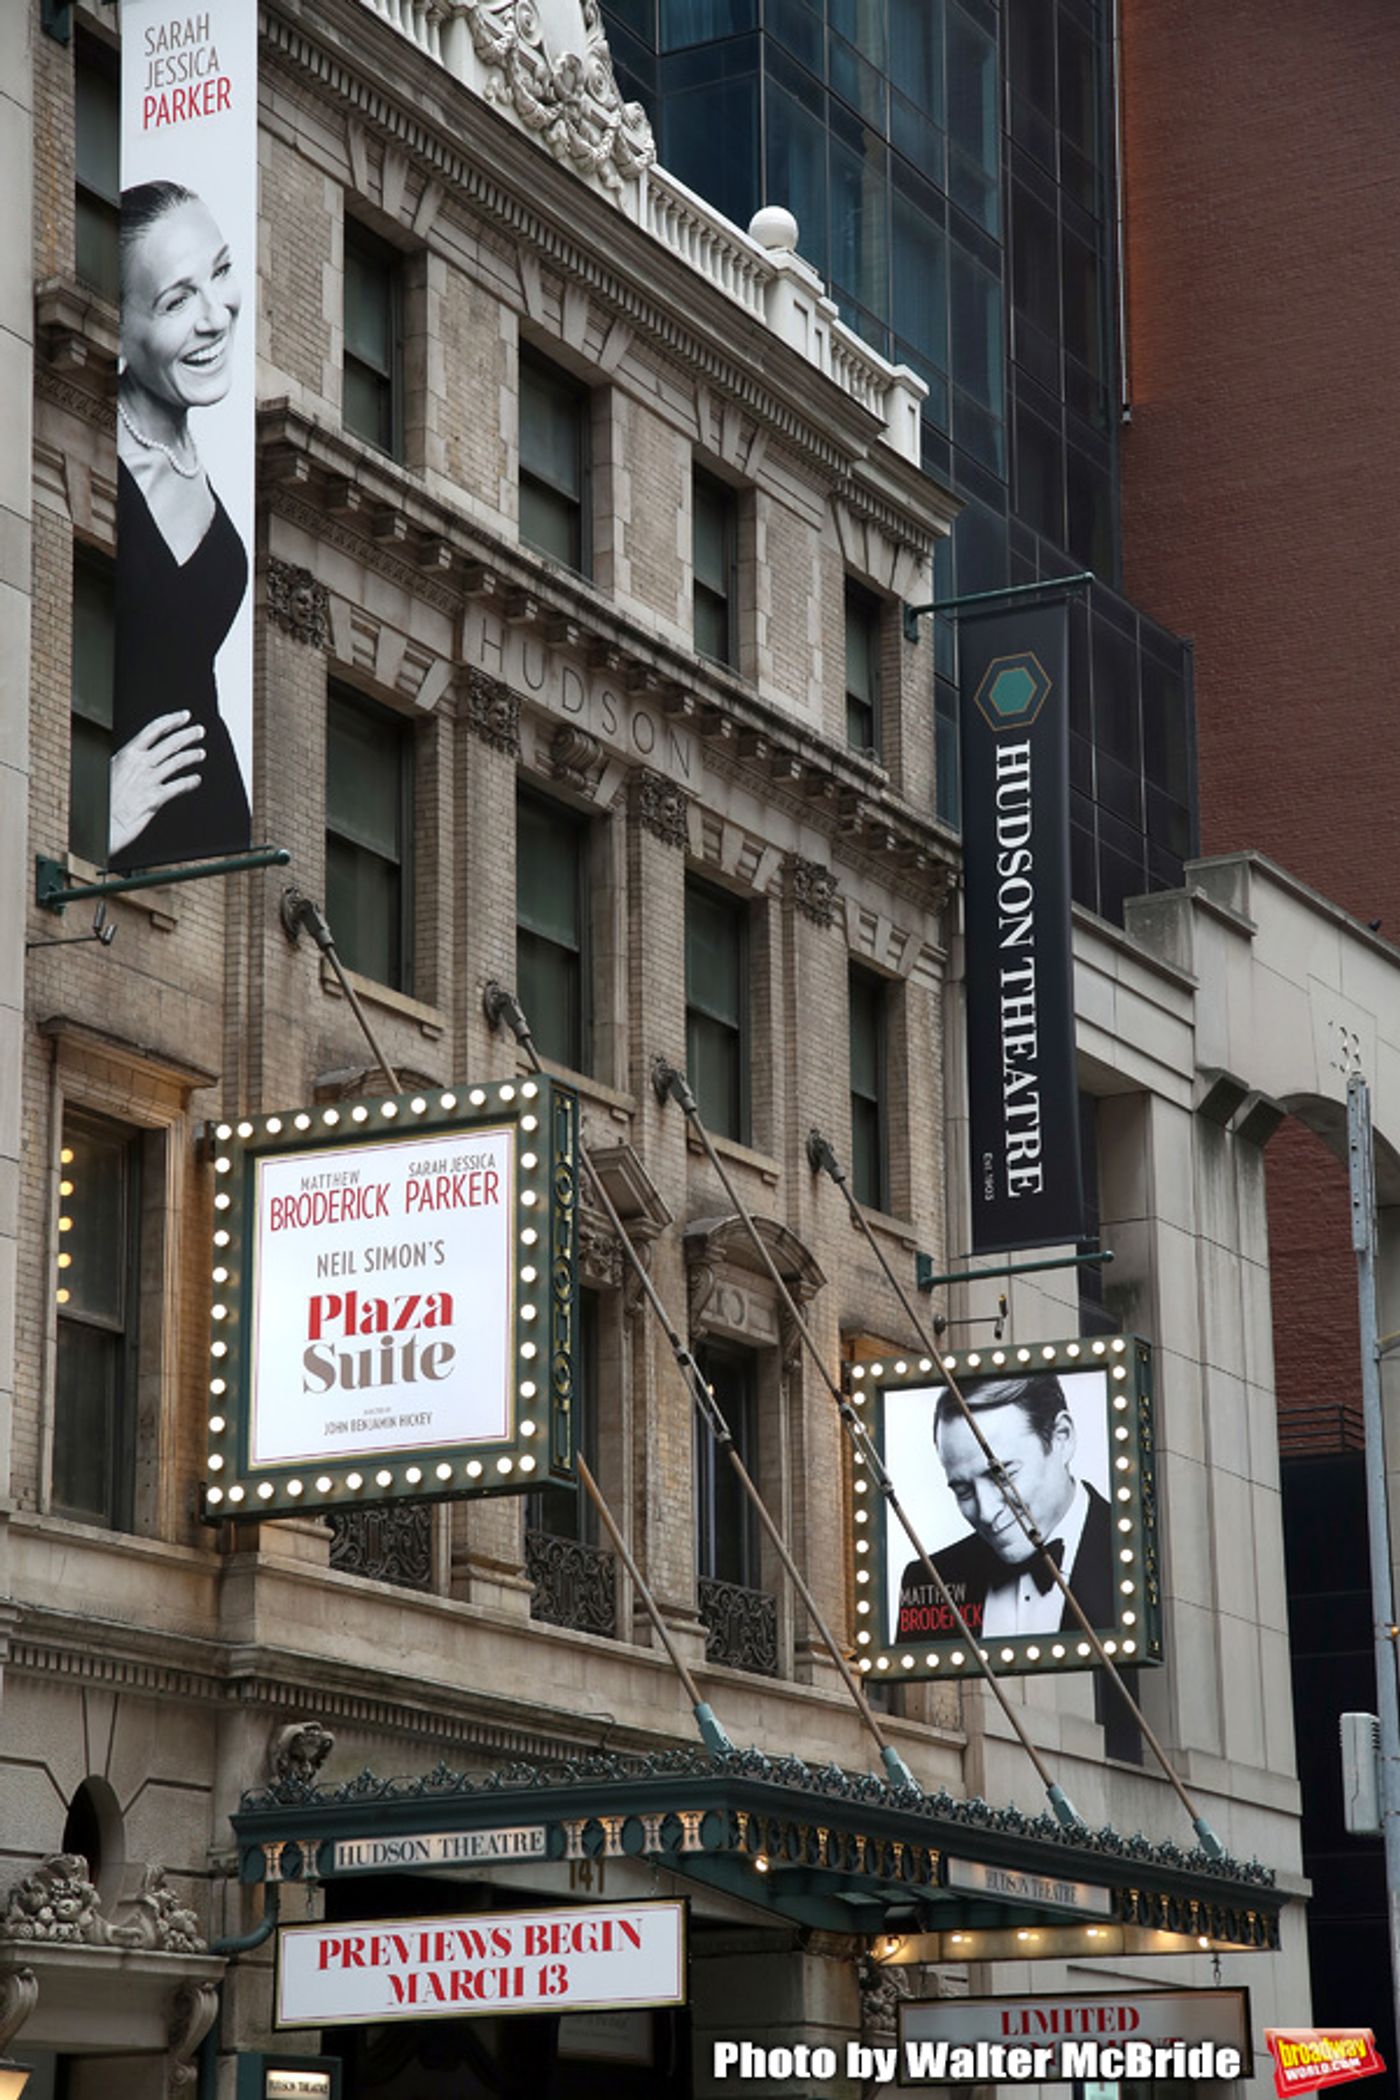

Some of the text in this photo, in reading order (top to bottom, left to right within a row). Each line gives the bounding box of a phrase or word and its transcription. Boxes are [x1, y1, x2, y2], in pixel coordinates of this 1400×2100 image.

[144, 12, 209, 57] SARAH
[144, 46, 220, 91] JESSICA
[143, 76, 231, 130] PARKER
[481, 618, 690, 779] HUDSON
[996, 739, 1043, 1197] HUDSON THEATRE
[300, 1170, 361, 1191] MATTHEW
[408, 1153, 496, 1177] SARAH JESSICA
[270, 1171, 499, 1231] BRODERICK PARKER
[317, 1240, 445, 1278] NEIL SIMON'S
[306, 1290, 456, 1341] Plaza
[303, 1334, 456, 1393] Suite
[338, 1829, 544, 1867] HUDSON THEATRE
[569, 1858, 606, 1894] 141
[317, 1919, 643, 1970] PREVIEWS BEGIN
[387, 1964, 569, 2005] MARCH 13
[1001, 2006, 1140, 2036] LIMITED
